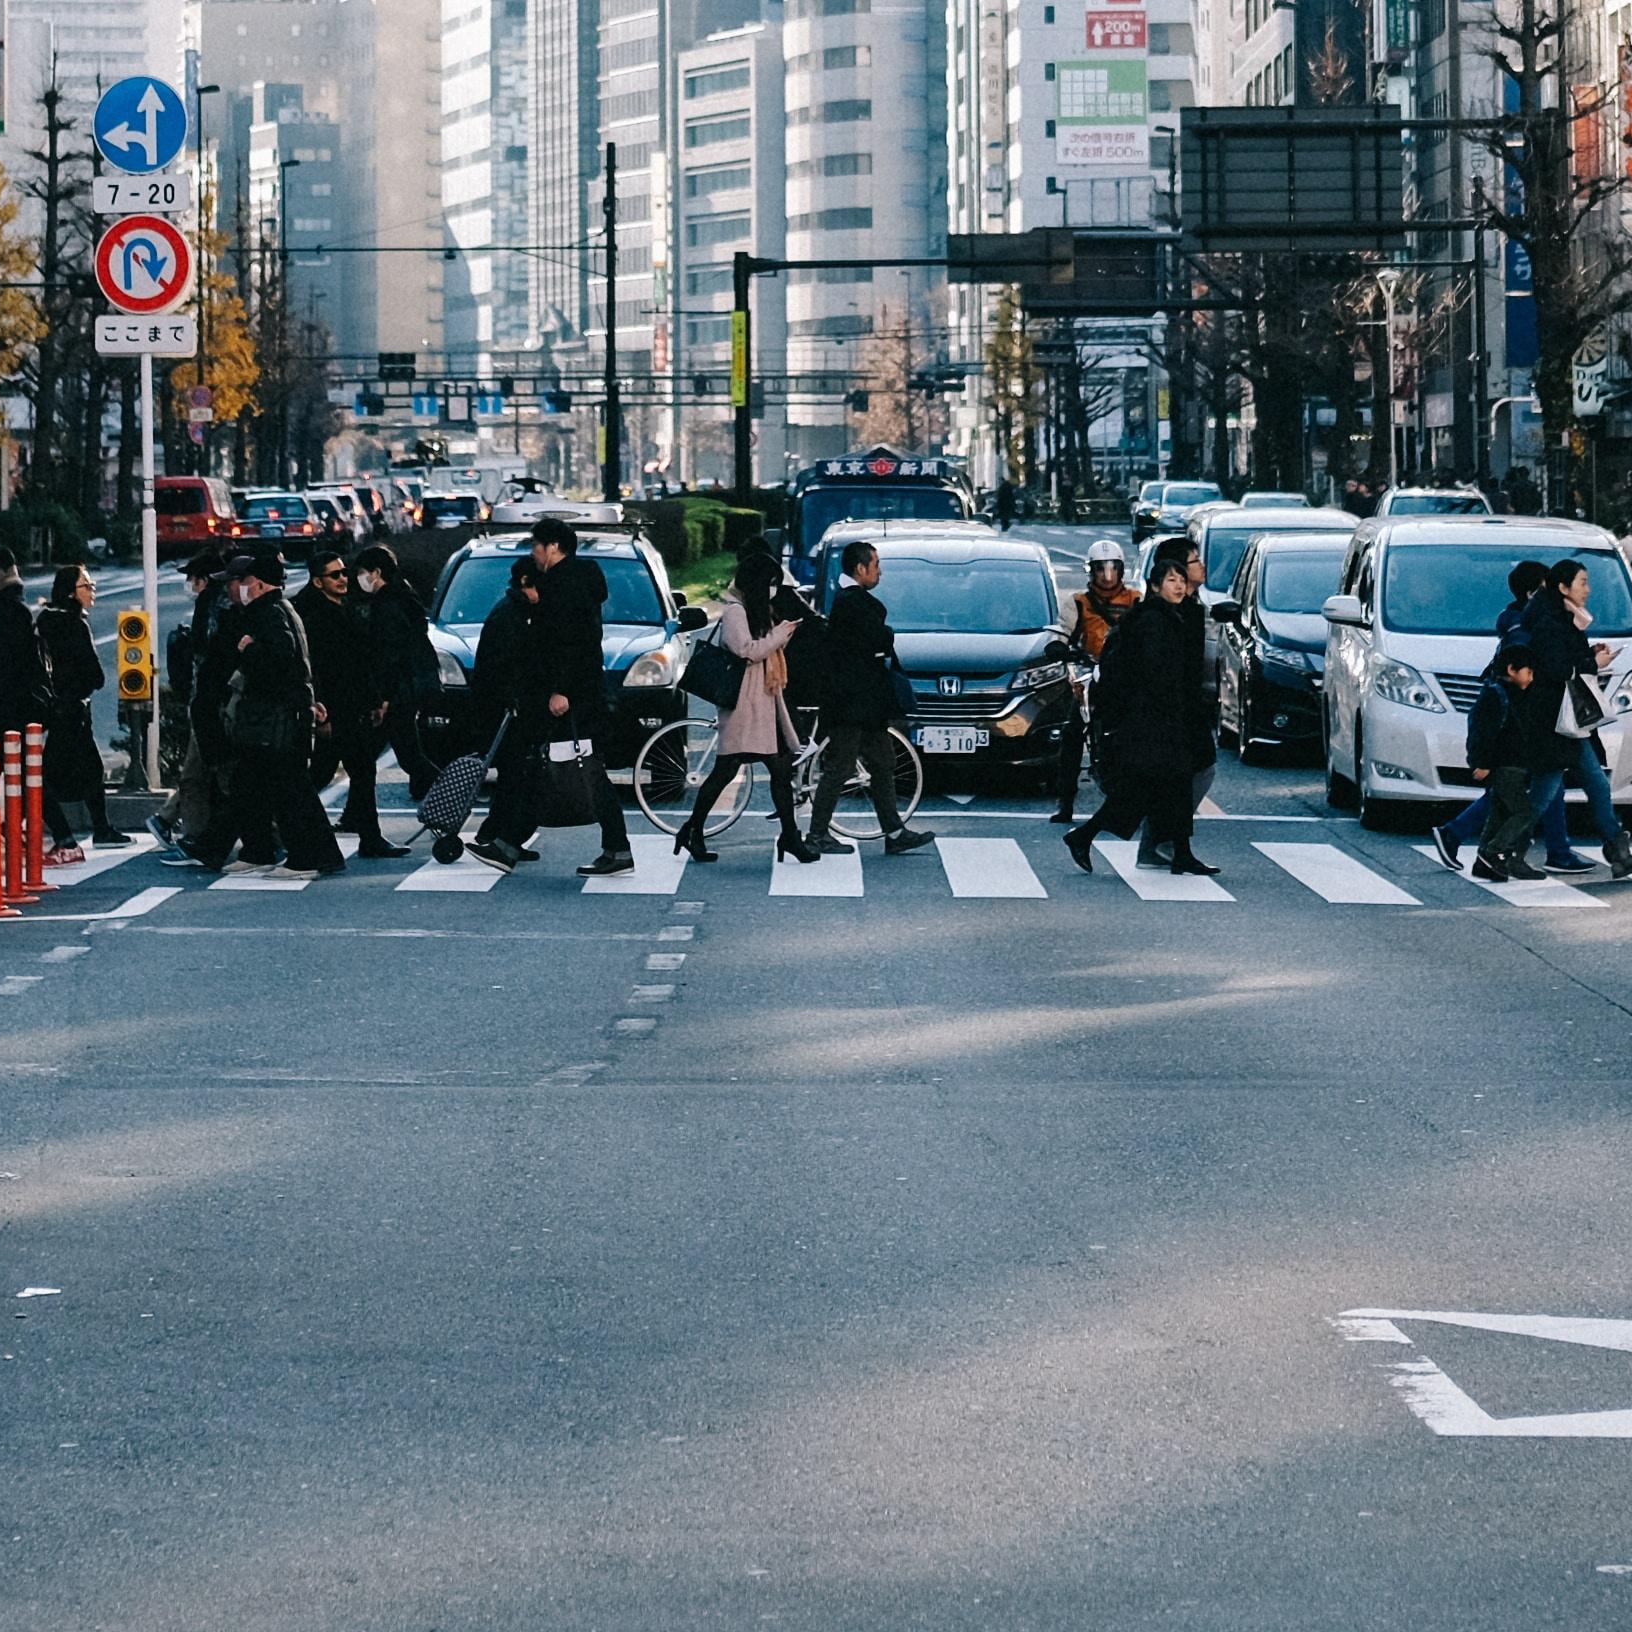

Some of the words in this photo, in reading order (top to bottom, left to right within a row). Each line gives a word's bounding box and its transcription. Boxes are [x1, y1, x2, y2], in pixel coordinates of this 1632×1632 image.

[1103, 21, 1141, 33] 200m
[1105, 146, 1144, 159] 500m
[104, 325, 185, 344] ここまで
[824, 460, 865, 476] 東京
[898, 459, 939, 477] 新聞
